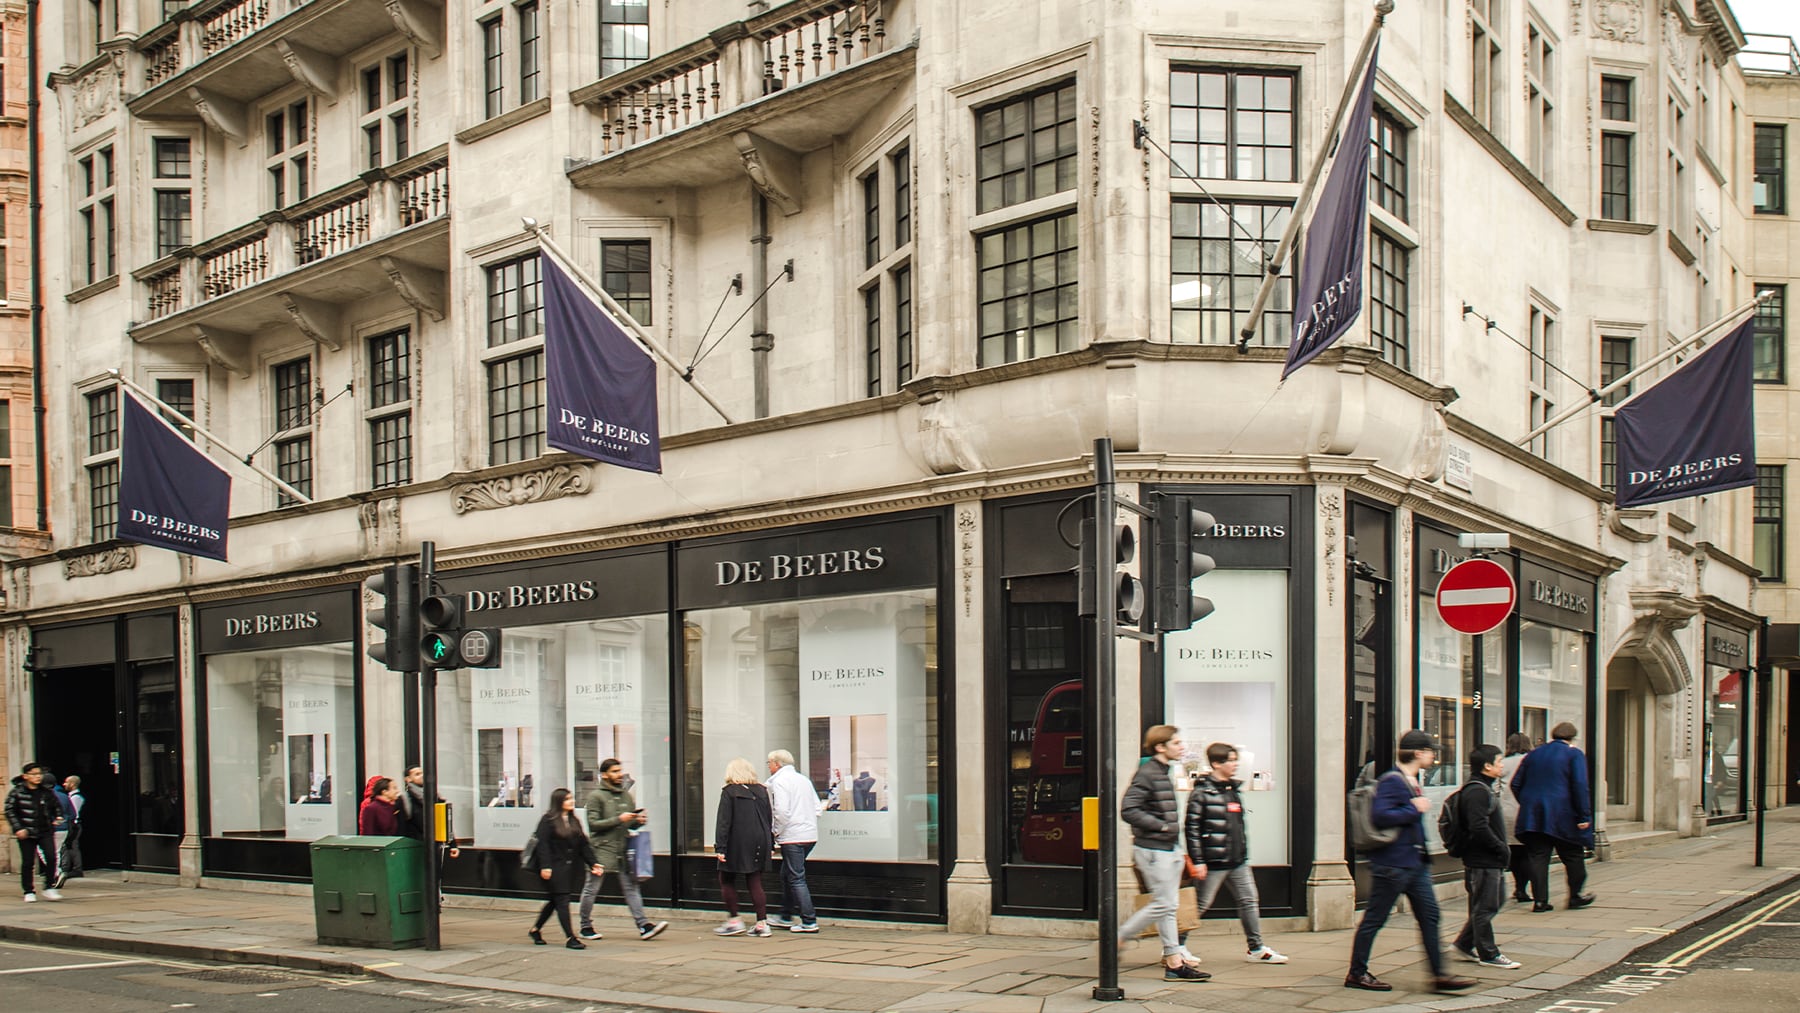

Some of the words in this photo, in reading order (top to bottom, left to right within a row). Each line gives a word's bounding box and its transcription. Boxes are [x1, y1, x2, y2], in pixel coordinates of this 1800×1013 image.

[560, 408, 586, 430] DE
[592, 418, 651, 446] BEERS
[581, 435, 629, 453] JEWELLERY
[1628, 470, 1663, 485] DE
[1668, 453, 1742, 479] BEERS
[131, 509, 158, 526] DE
[162, 516, 221, 541] BEERS
[1213, 523, 1286, 538] BEERS
[715, 560, 763, 586] DE
[770, 546, 885, 581] BEERS
[466, 590, 503, 612] DE
[508, 580, 595, 608] BEERS
[1534, 580, 1552, 604] DE
[1554, 585, 1589, 614] BEERS
[226, 617, 253, 637] DE
[255, 611, 319, 634] BEERS
[1179, 648, 1206, 660] DE
[1212, 648, 1273, 660] BEERS
[812, 669, 833, 681] DE
[836, 667, 885, 679] BEERS
[480, 688, 495, 699] DE
[497, 687, 531, 697] BEERS
[576, 684, 593, 695] DE
[595, 682, 633, 693] BEERS
